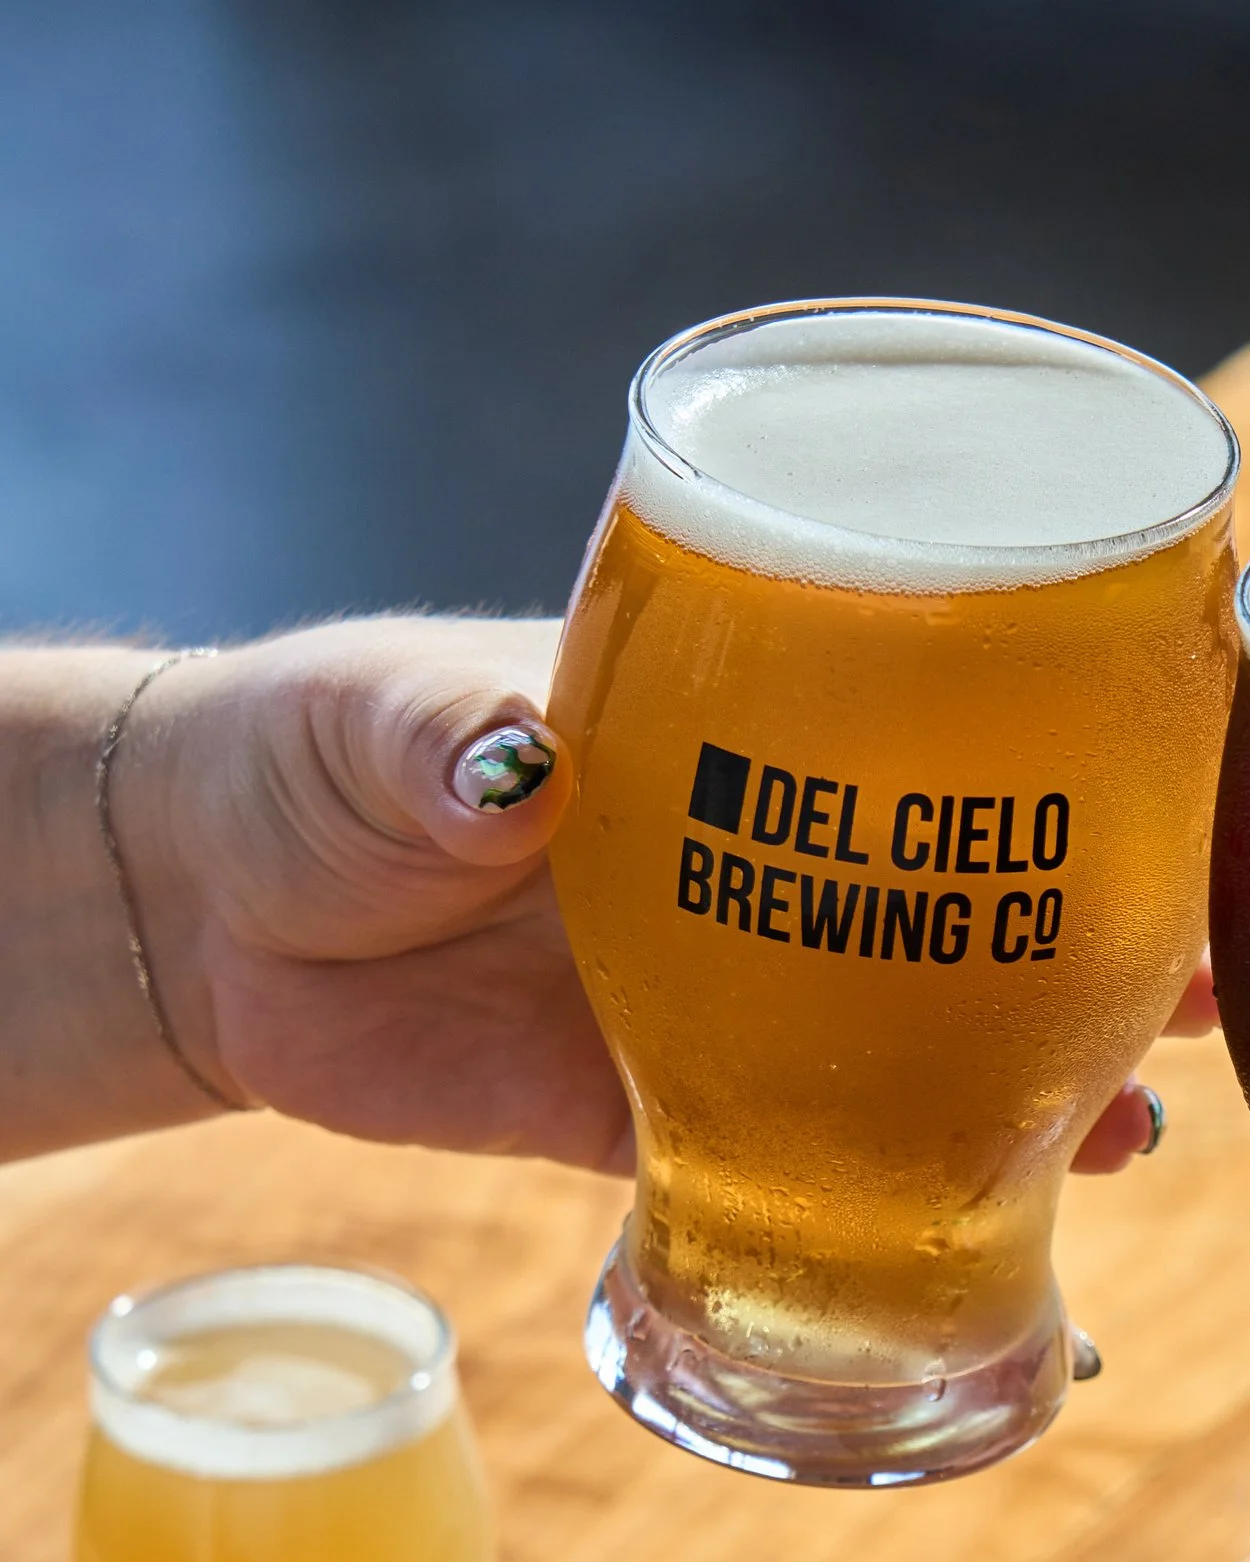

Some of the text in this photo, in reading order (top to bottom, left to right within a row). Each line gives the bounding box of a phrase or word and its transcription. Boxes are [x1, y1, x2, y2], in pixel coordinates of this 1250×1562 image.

[751, 765, 1070, 874] DEL CIELO
[677, 836, 972, 964] BREWING
